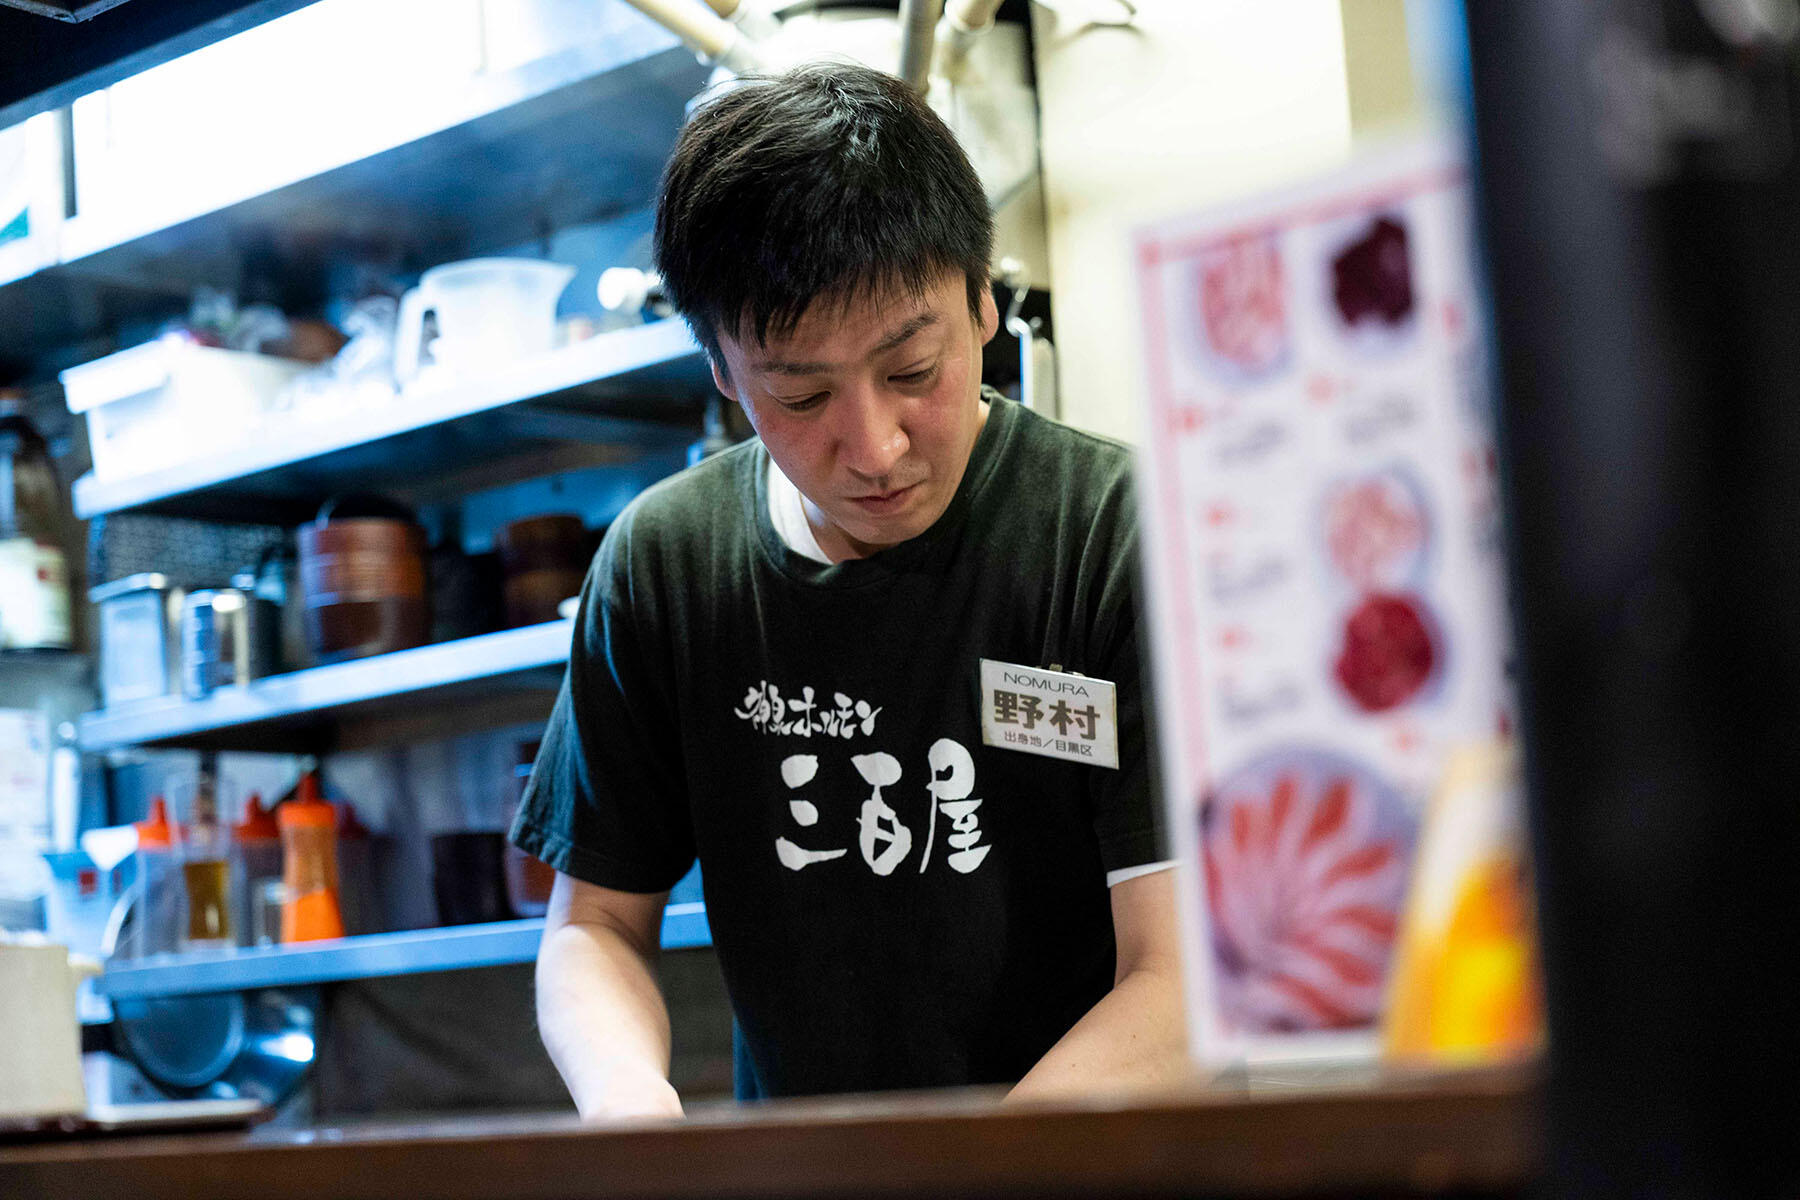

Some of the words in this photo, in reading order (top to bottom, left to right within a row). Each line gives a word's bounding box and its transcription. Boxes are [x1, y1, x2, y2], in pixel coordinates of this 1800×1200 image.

[1004, 672, 1089, 698] NOMURA
[993, 689, 1101, 741] 野村
[775, 738, 992, 876] 三百屋
